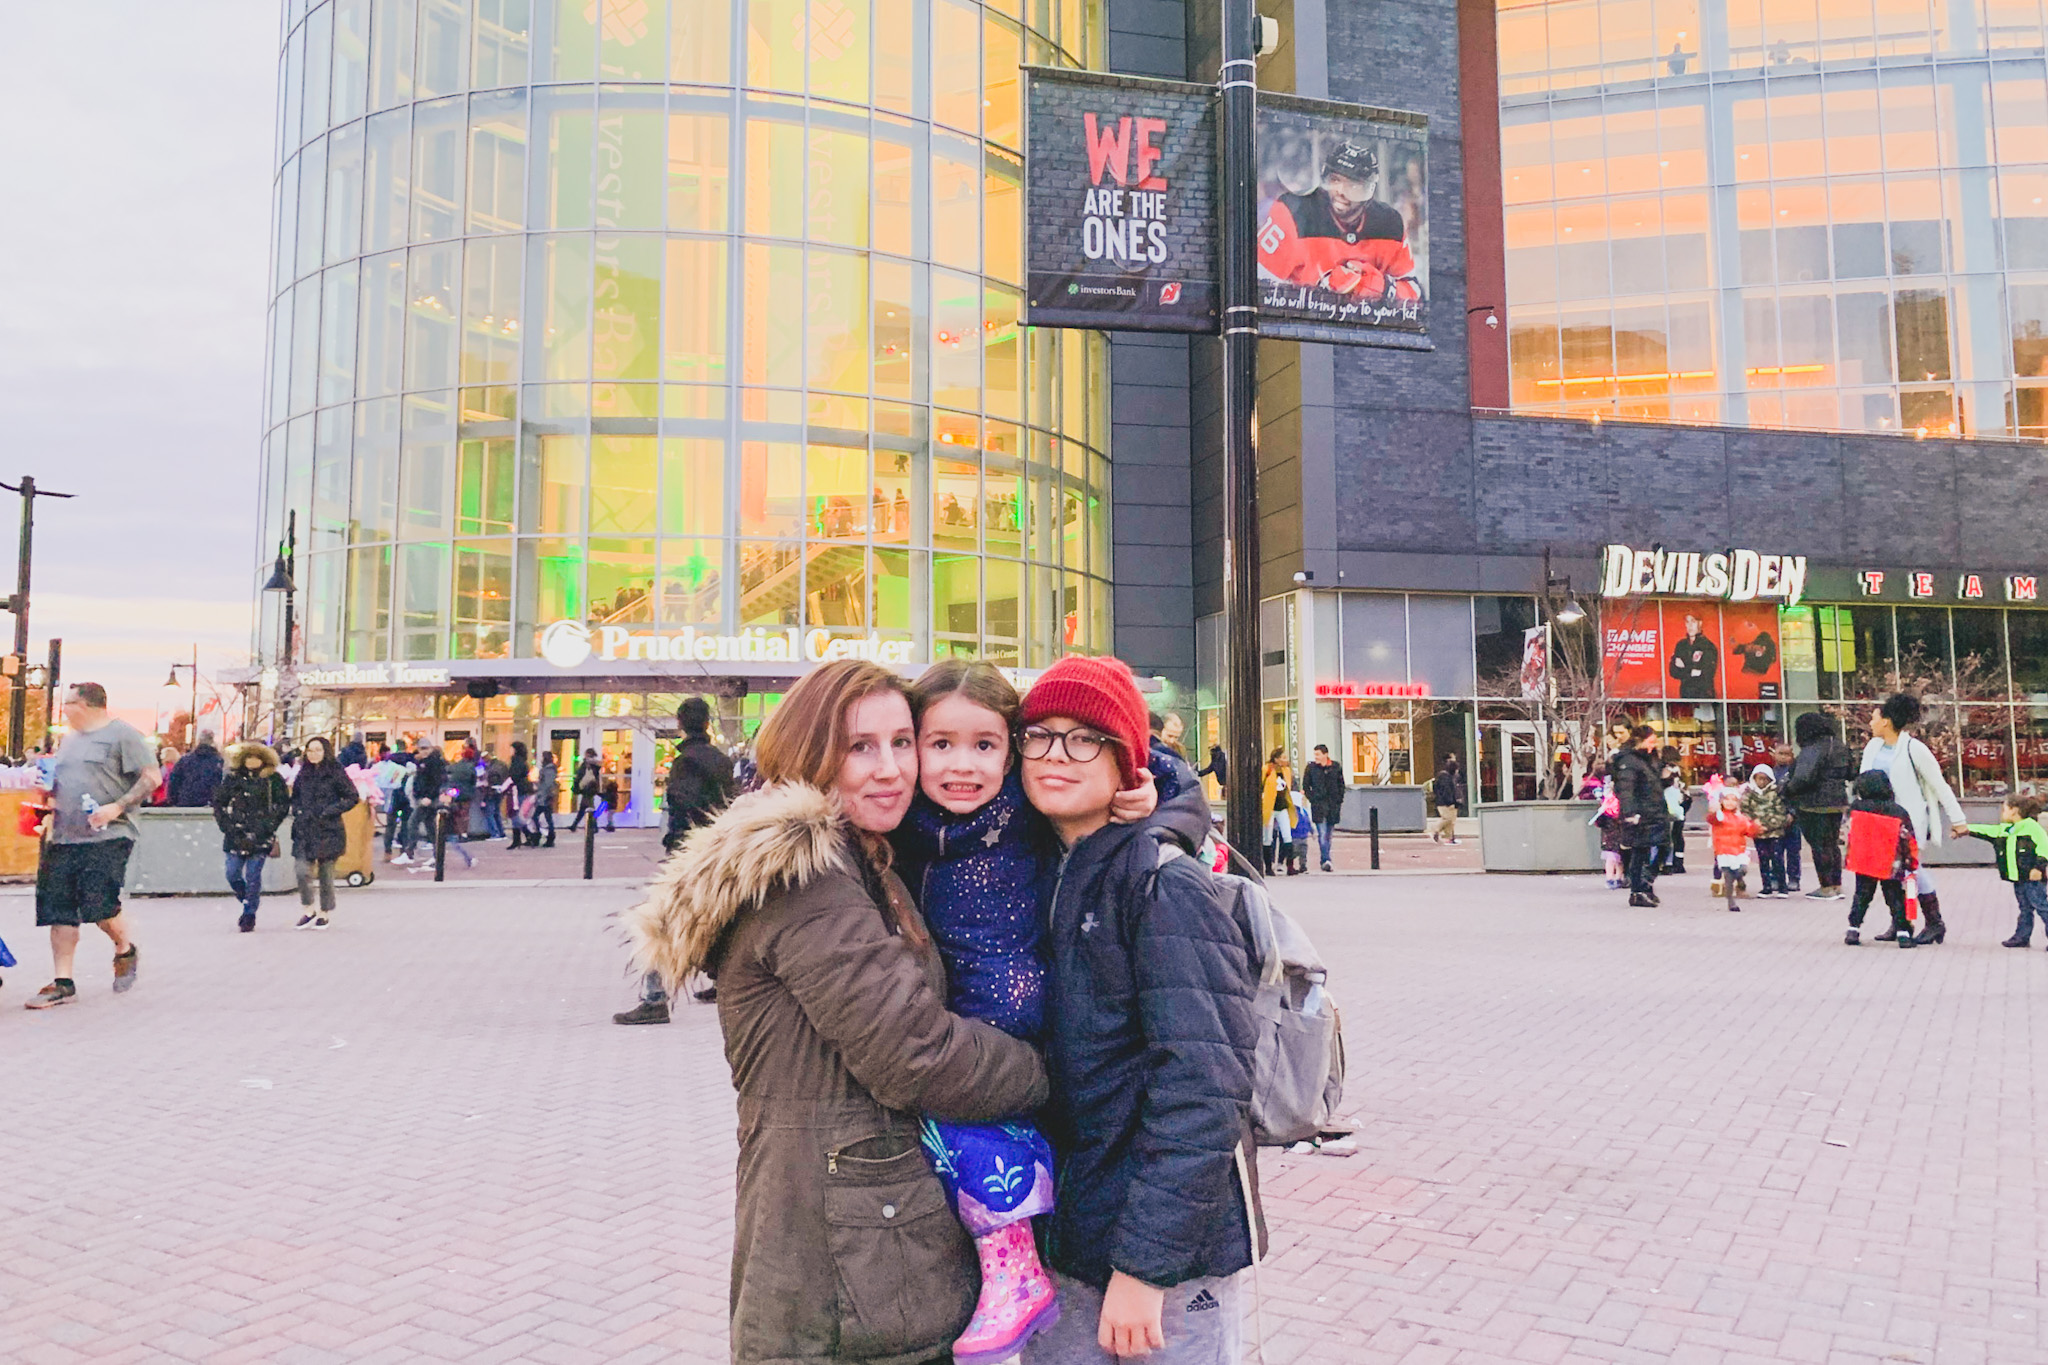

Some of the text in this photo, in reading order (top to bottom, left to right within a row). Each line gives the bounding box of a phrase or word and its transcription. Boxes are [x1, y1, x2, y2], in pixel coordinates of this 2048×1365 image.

[1084, 112, 1168, 191] WE
[1083, 188, 1167, 220] ARE THE
[1083, 216, 1167, 263] ONES
[1264, 287, 1287, 307] who
[1288, 287, 1307, 309] will
[1308, 291, 1336, 319] bring
[1339, 300, 1359, 321] you
[1360, 299, 1371, 316] to
[1373, 306, 1398, 325] your
[1730, 548, 1807, 607] DEN
[1858, 571, 2037, 600] TEAM
[599, 625, 915, 663] Prudential Center
[1606, 629, 1657, 643] GAME
[392, 662, 449, 684] Tower
[1187, 1301, 1219, 1312] adidas
